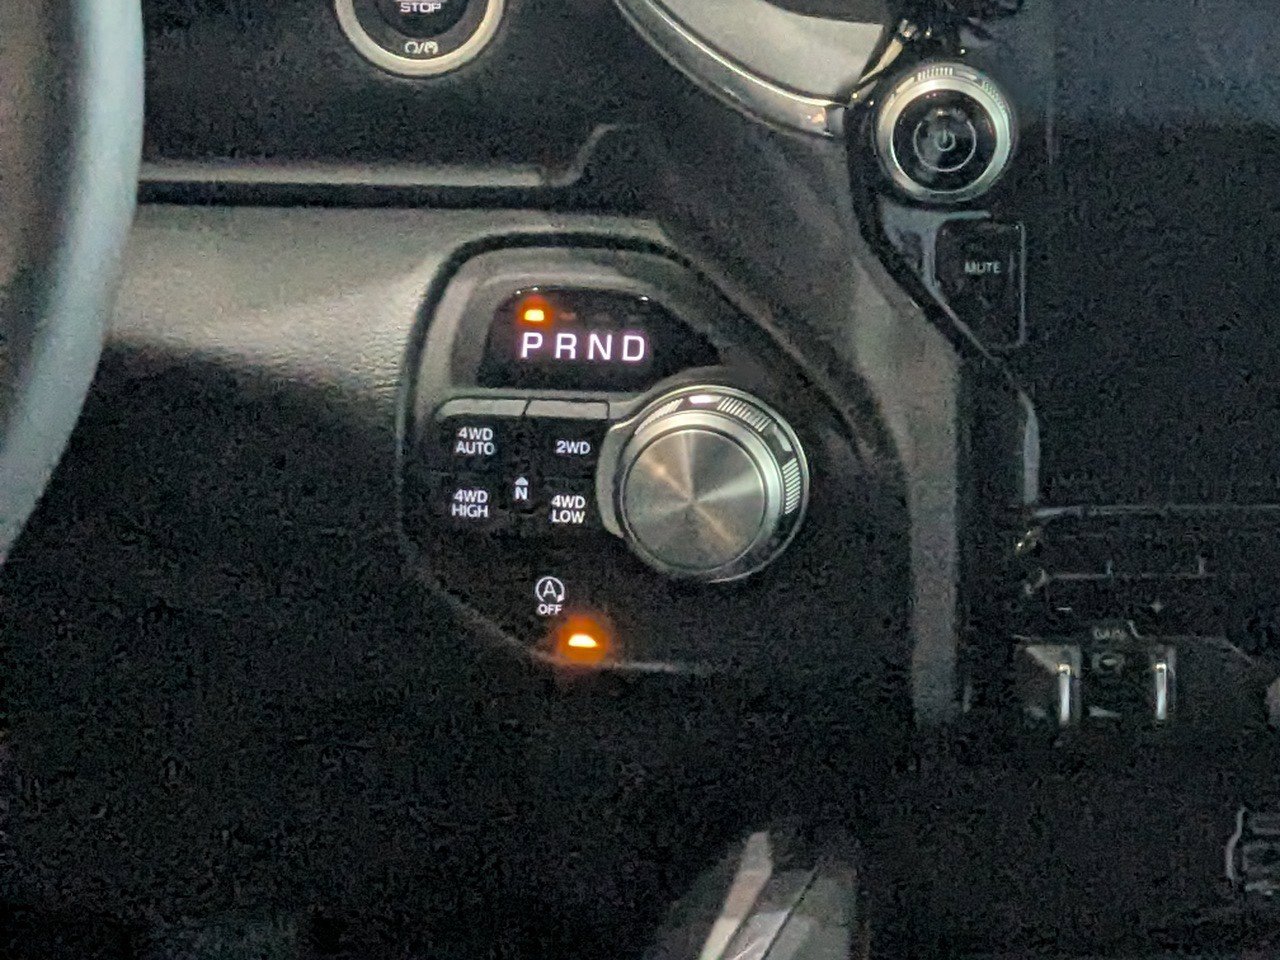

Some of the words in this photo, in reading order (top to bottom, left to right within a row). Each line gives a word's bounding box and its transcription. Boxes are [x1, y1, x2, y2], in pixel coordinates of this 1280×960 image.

[400, 2, 442, 13] STOP
[964, 261, 1001, 274] MUTE
[458, 427, 494, 440] 4WD
[455, 441, 495, 455] AUTO
[555, 441, 591, 454] 2WD
[453, 490, 488, 503] 4WD
[515, 487, 528, 500] N
[551, 495, 586, 509] 4WD
[451, 504, 489, 518] HIGH
[552, 510, 585, 524] LOW
[538, 604, 562, 615] OFF
